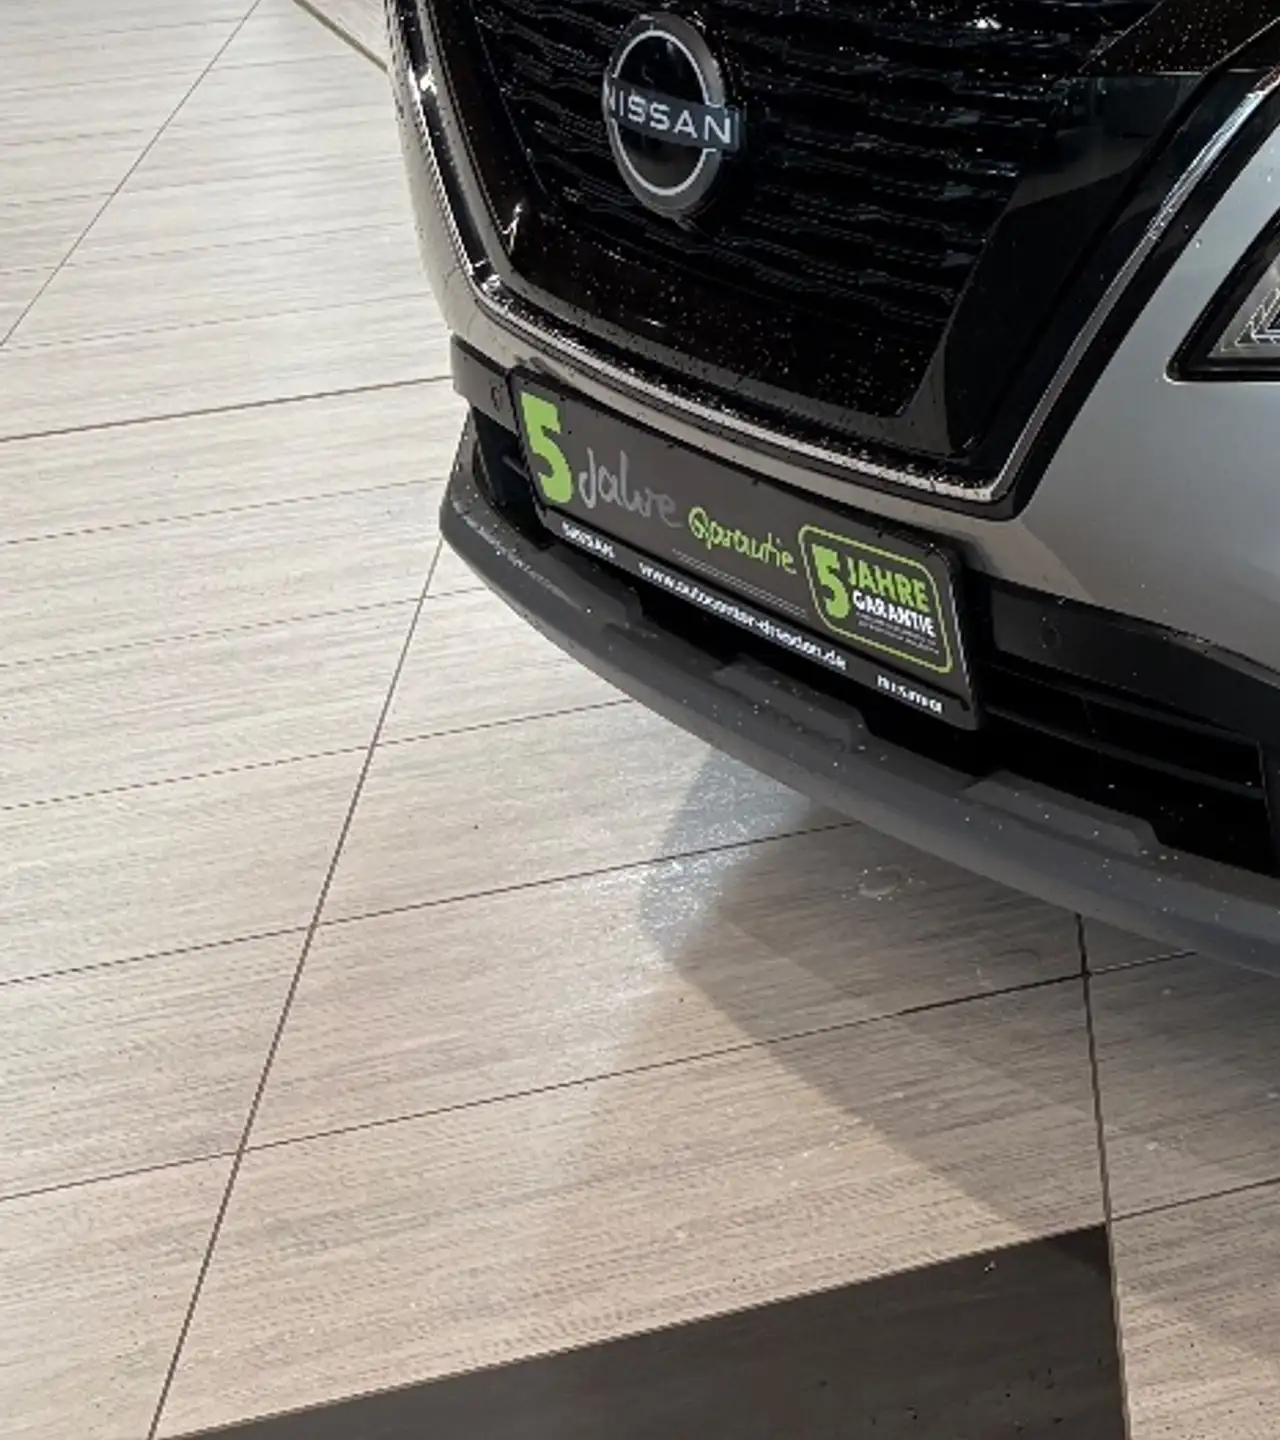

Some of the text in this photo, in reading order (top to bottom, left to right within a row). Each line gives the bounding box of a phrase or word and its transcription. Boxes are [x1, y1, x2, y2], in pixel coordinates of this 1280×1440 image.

[520, 391, 574, 503] 5
[578, 446, 684, 528] Jahre
[811, 542, 850, 619] 5
[847, 555, 931, 613] JAHRE
[852, 589, 937, 639] GARANTIE
